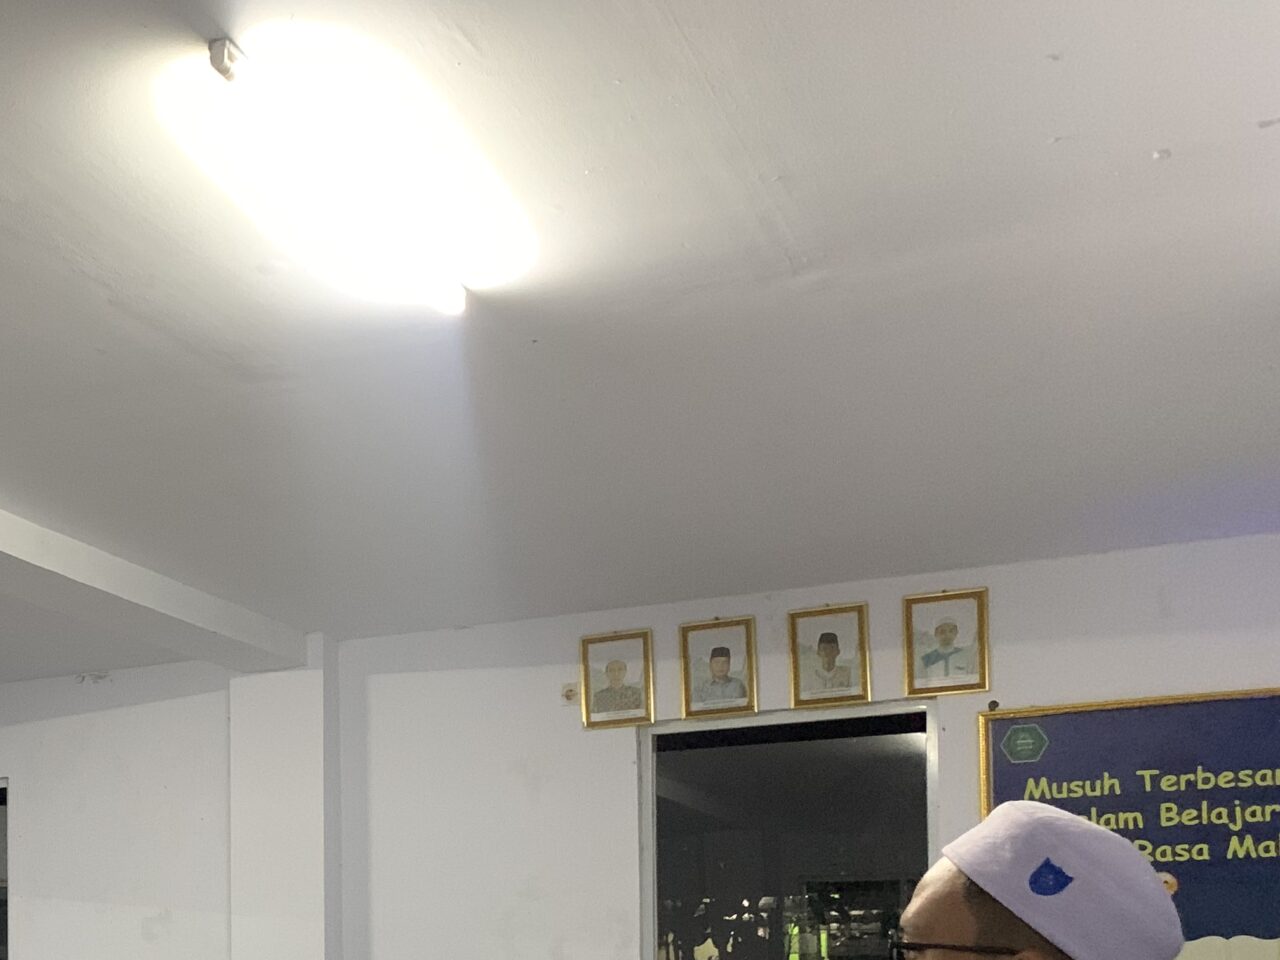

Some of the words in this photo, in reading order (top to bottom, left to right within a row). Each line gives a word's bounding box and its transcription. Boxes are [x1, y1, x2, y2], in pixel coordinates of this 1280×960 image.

[1024, 772, 1121, 800] Musuh
[1078, 807, 1144, 830] lam
[1160, 800, 1280, 831] Belajar
[1227, 834, 1280, 859] Ma
